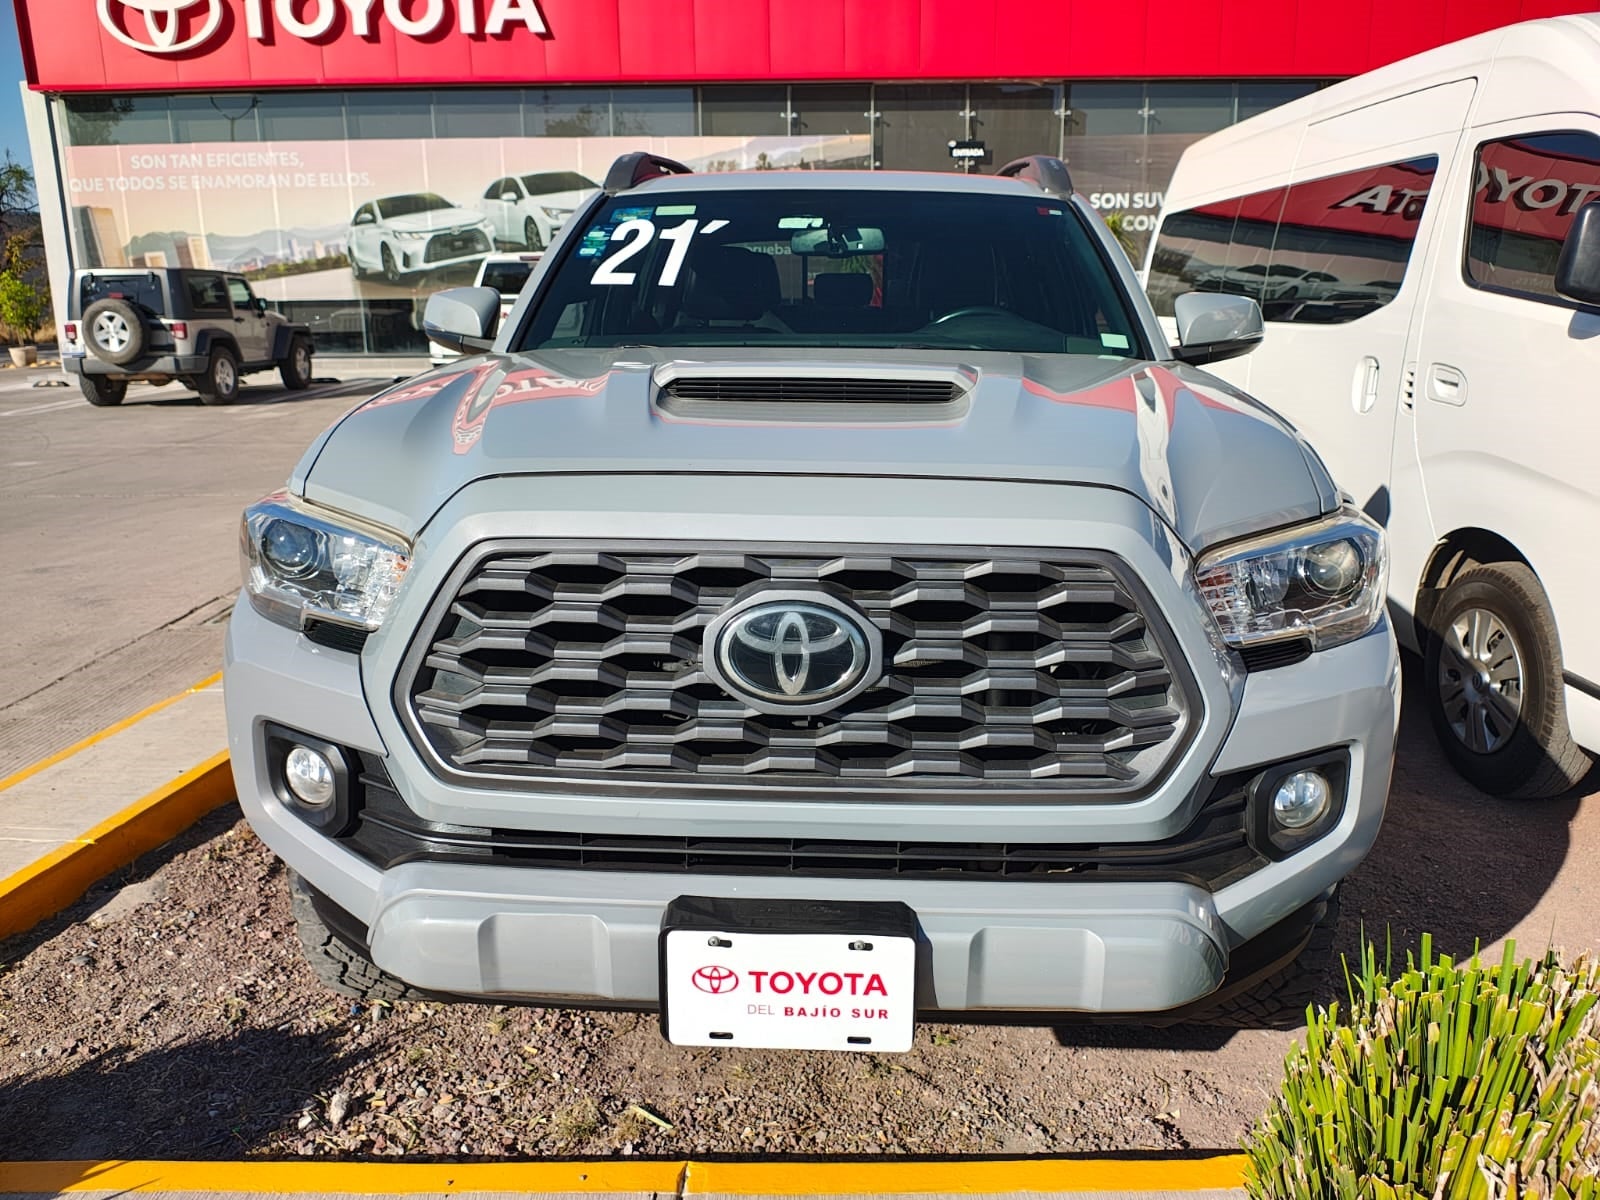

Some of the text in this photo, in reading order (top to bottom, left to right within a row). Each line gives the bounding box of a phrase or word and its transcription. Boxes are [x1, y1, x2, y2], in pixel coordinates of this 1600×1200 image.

[245, 0, 547, 38] TOYOTA
[130, 151, 305, 169] SON TAN EFICIENTES,
[69, 171, 376, 192] QUE TODOS SE ENAMORAN DE ELLOS.
[1090, 192, 1130, 209] SON
[748, 971, 889, 997] TOYOTA
[747, 1004, 889, 1020] DEL BAJÍO SUR
